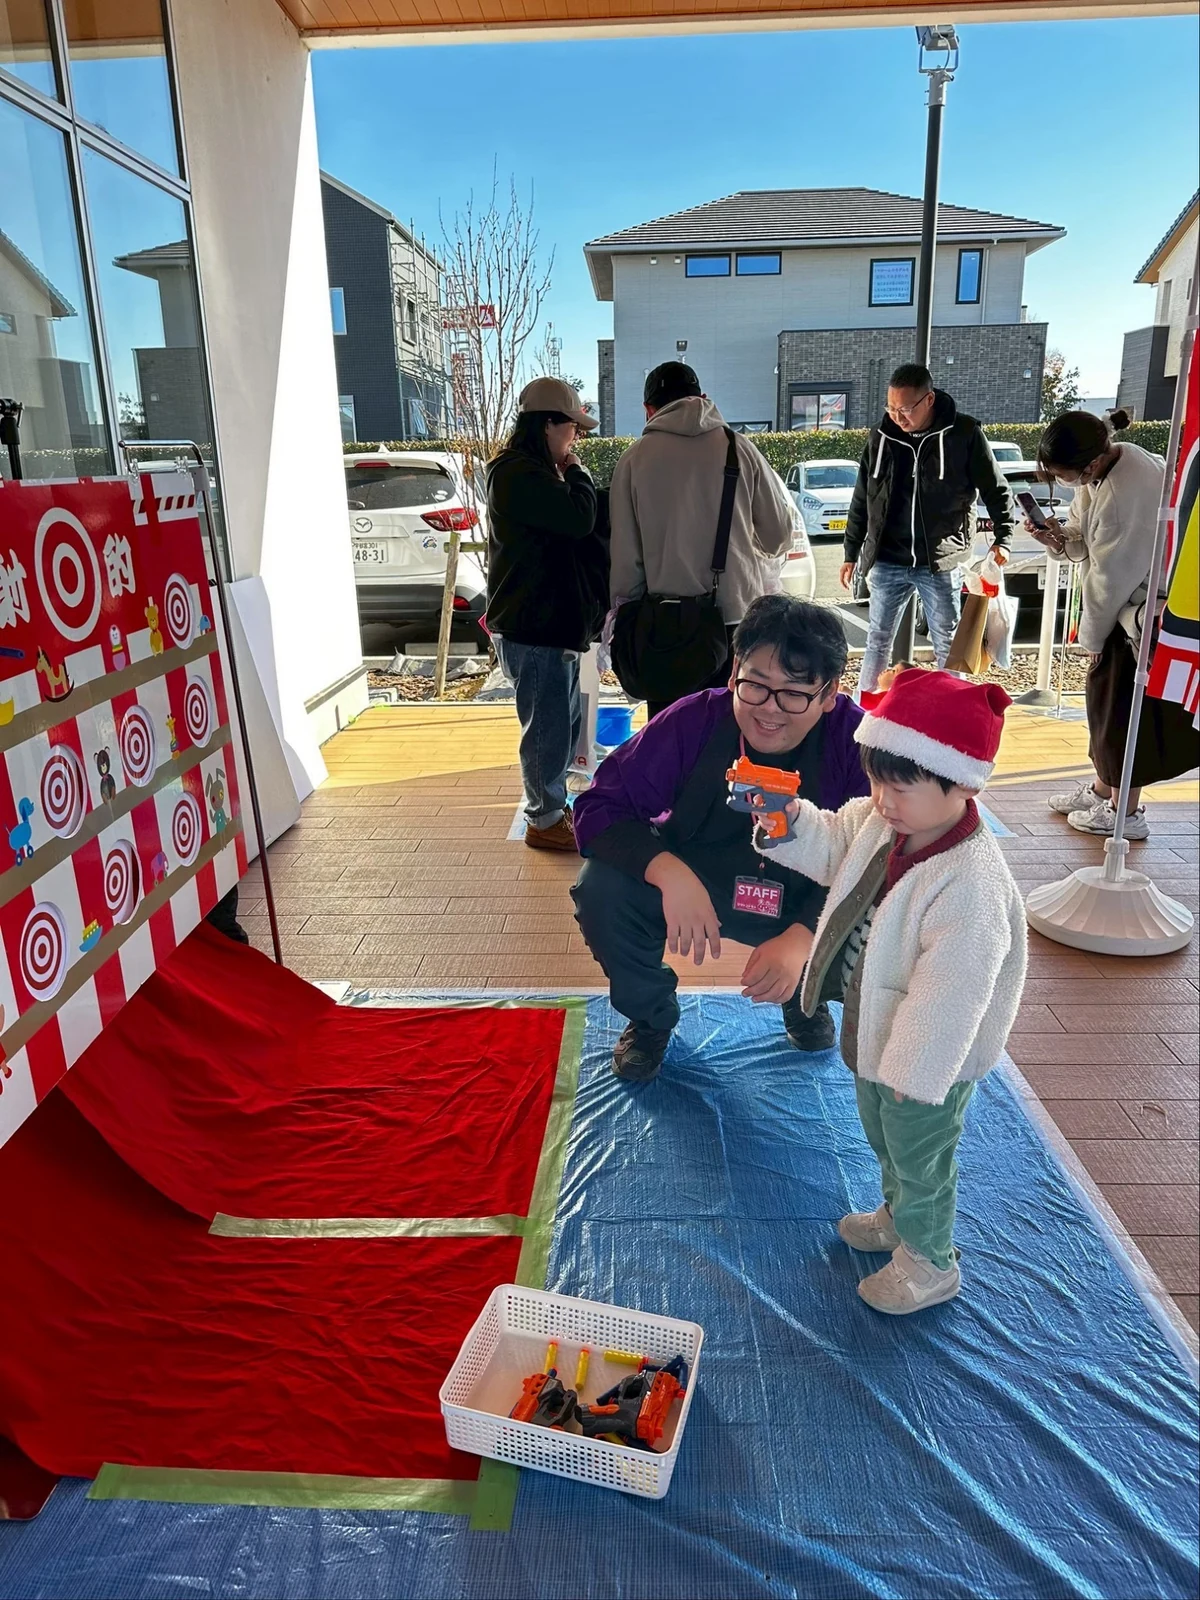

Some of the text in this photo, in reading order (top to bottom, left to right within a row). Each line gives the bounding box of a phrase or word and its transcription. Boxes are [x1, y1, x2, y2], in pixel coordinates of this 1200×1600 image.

[355, 549, 384, 561] 48-31
[103, 532, 136, 598] 的
[738, 884, 778, 900] STAFF
